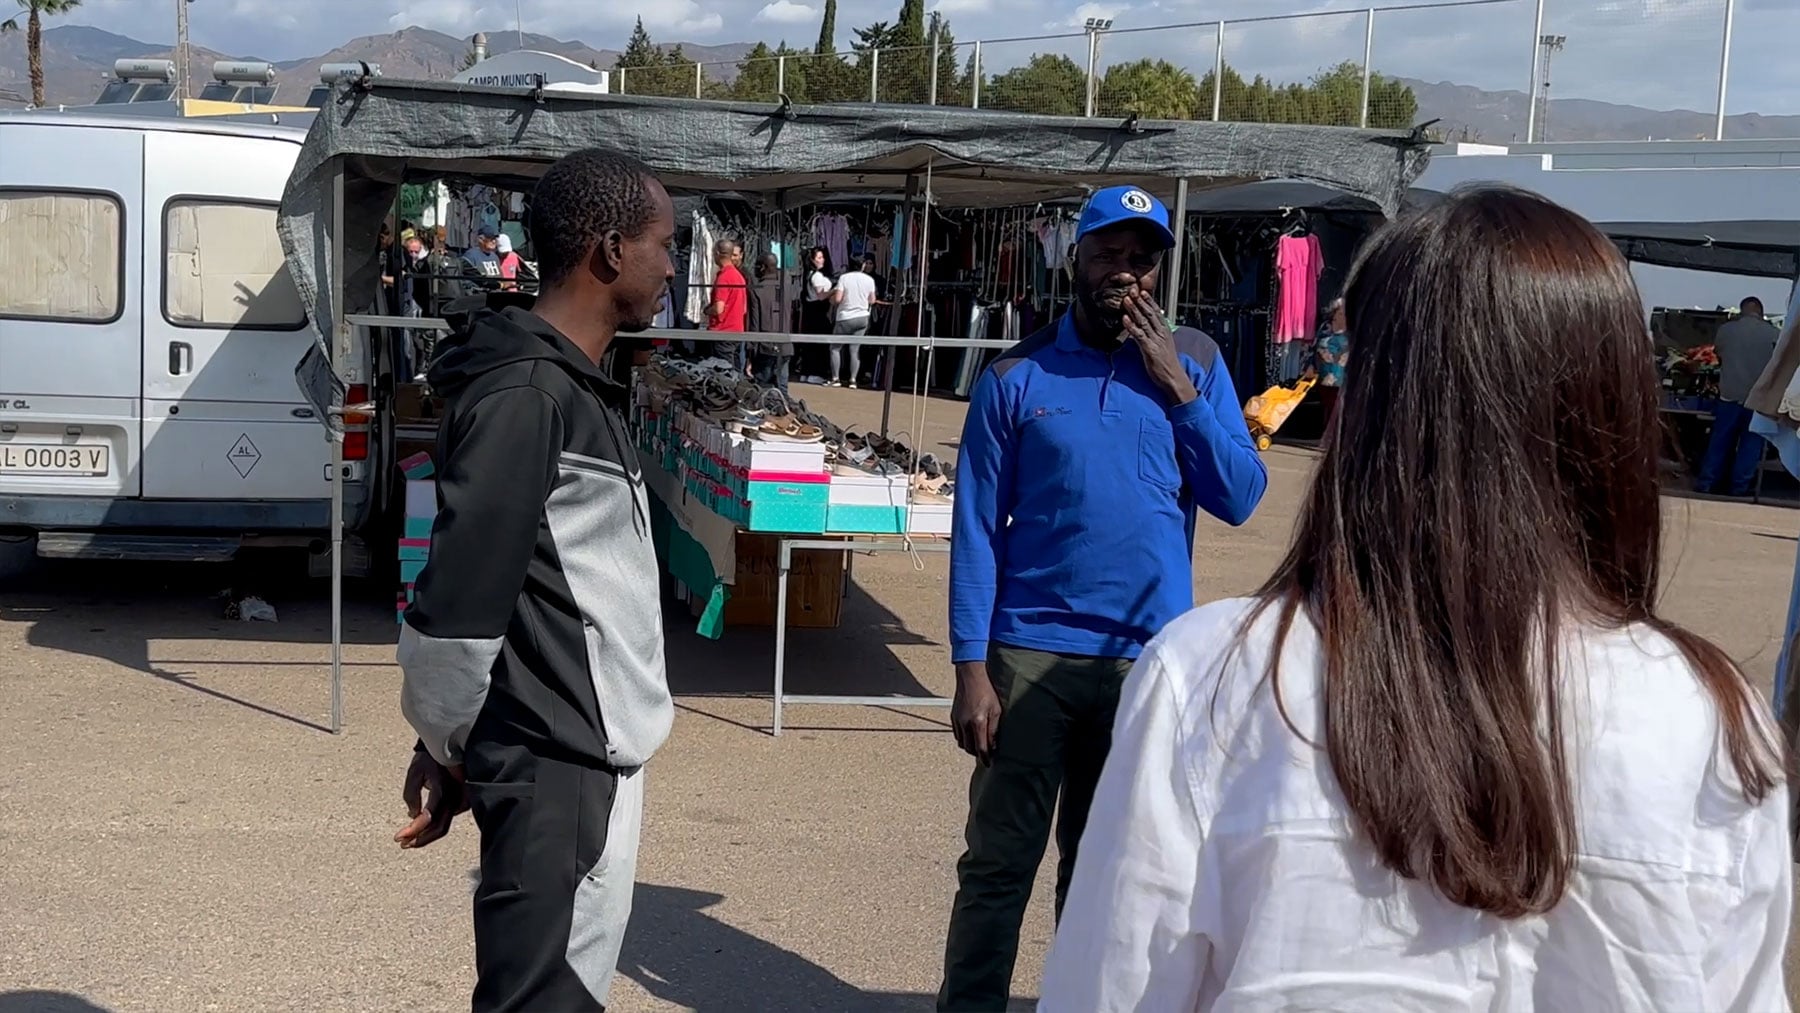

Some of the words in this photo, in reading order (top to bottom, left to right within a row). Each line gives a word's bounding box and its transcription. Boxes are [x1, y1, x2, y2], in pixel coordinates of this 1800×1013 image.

[468, 75, 499, 86] CAMPO
[501, 72, 548, 87] MUNICIPL
[13, 399, 30, 409] CL
[238, 446, 250, 454] AL
[24, 448, 81, 469] 0003
[89, 449, 101, 469] V
